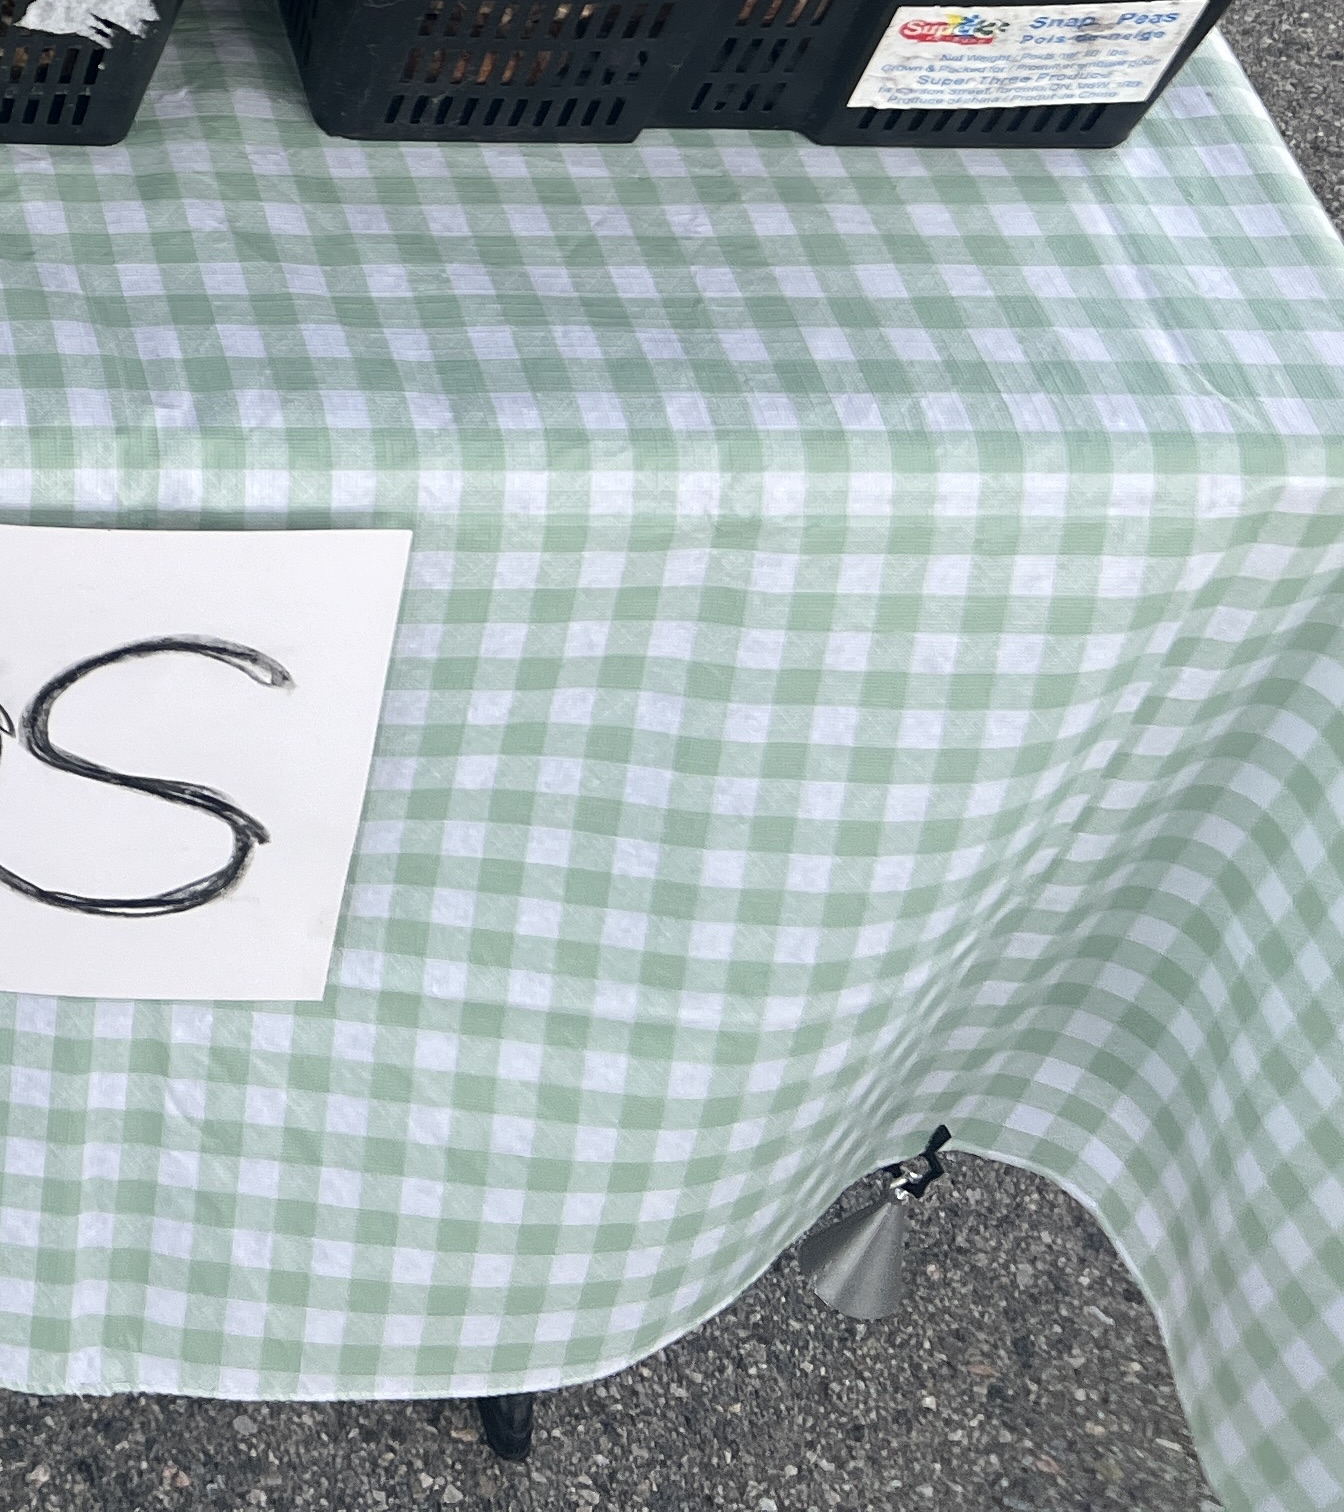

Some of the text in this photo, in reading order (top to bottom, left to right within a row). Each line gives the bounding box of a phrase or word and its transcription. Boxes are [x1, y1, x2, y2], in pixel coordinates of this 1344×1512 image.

[1028, 12, 1181, 29] Snap Peas
[916, 74, 974, 87] Super
[979, 74, 1033, 87] Three
